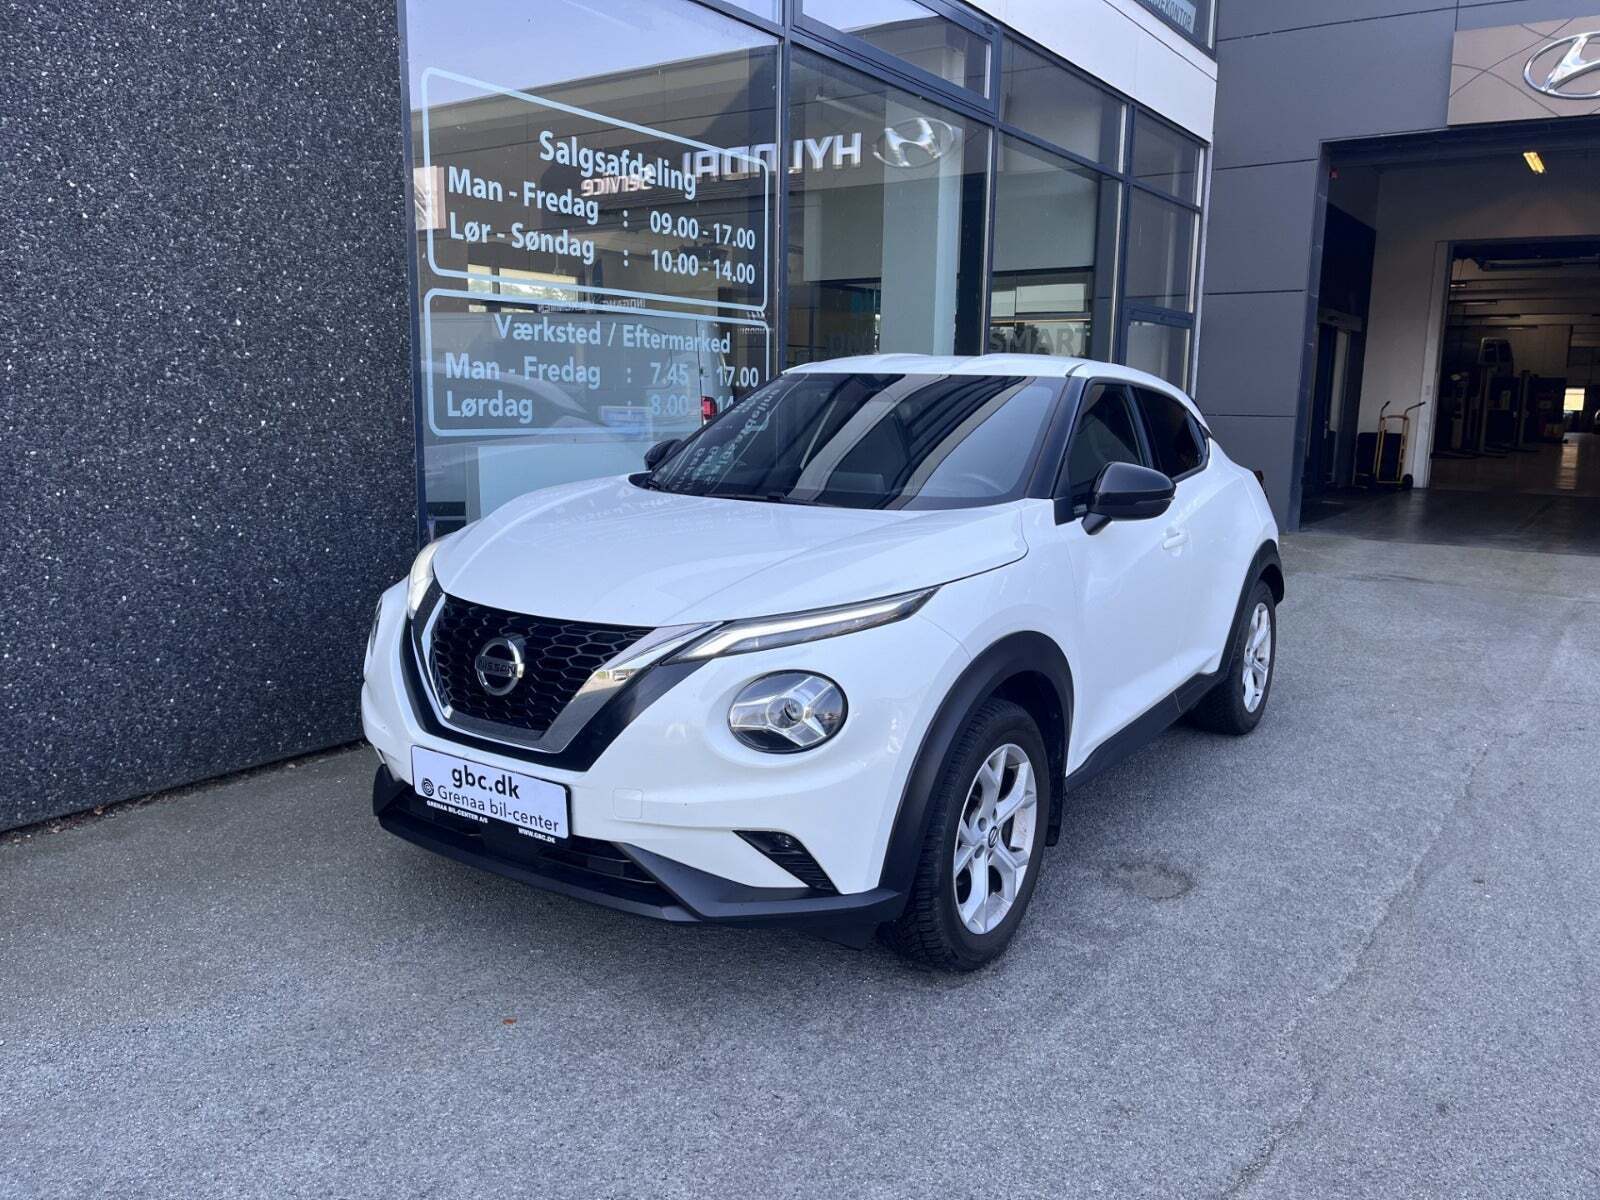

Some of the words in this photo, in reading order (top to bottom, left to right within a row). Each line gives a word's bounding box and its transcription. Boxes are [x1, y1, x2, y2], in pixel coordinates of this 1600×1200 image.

[539, 130, 696, 200] Salgsafdeling
[448, 166, 503, 202] Man
[523, 181, 599, 225] Fredag
[650, 210, 699, 240] 09.00
[713, 223, 756, 250] 17.00
[450, 212, 491, 244] Lør
[511, 223, 595, 266] Søndag
[651, 249, 699, 277] 10.00
[713, 260, 756, 286] 14.00
[494, 314, 601, 345] Værksted
[607, 322, 617, 347] /
[622, 324, 731, 354] Eftermarked
[446, 352, 500, 381] Man
[523, 356, 601, 391] Fredag
[650, 362, 689, 387] 7.45
[716, 366, 759, 387] 17.00
[446, 390, 534, 423] Lørdag
[651, 393, 689, 417] 8.00
[451, 765, 521, 799] gbc.dk
[437, 785, 486, 812] Grenaa
[489, 799, 560, 832] bil-center
